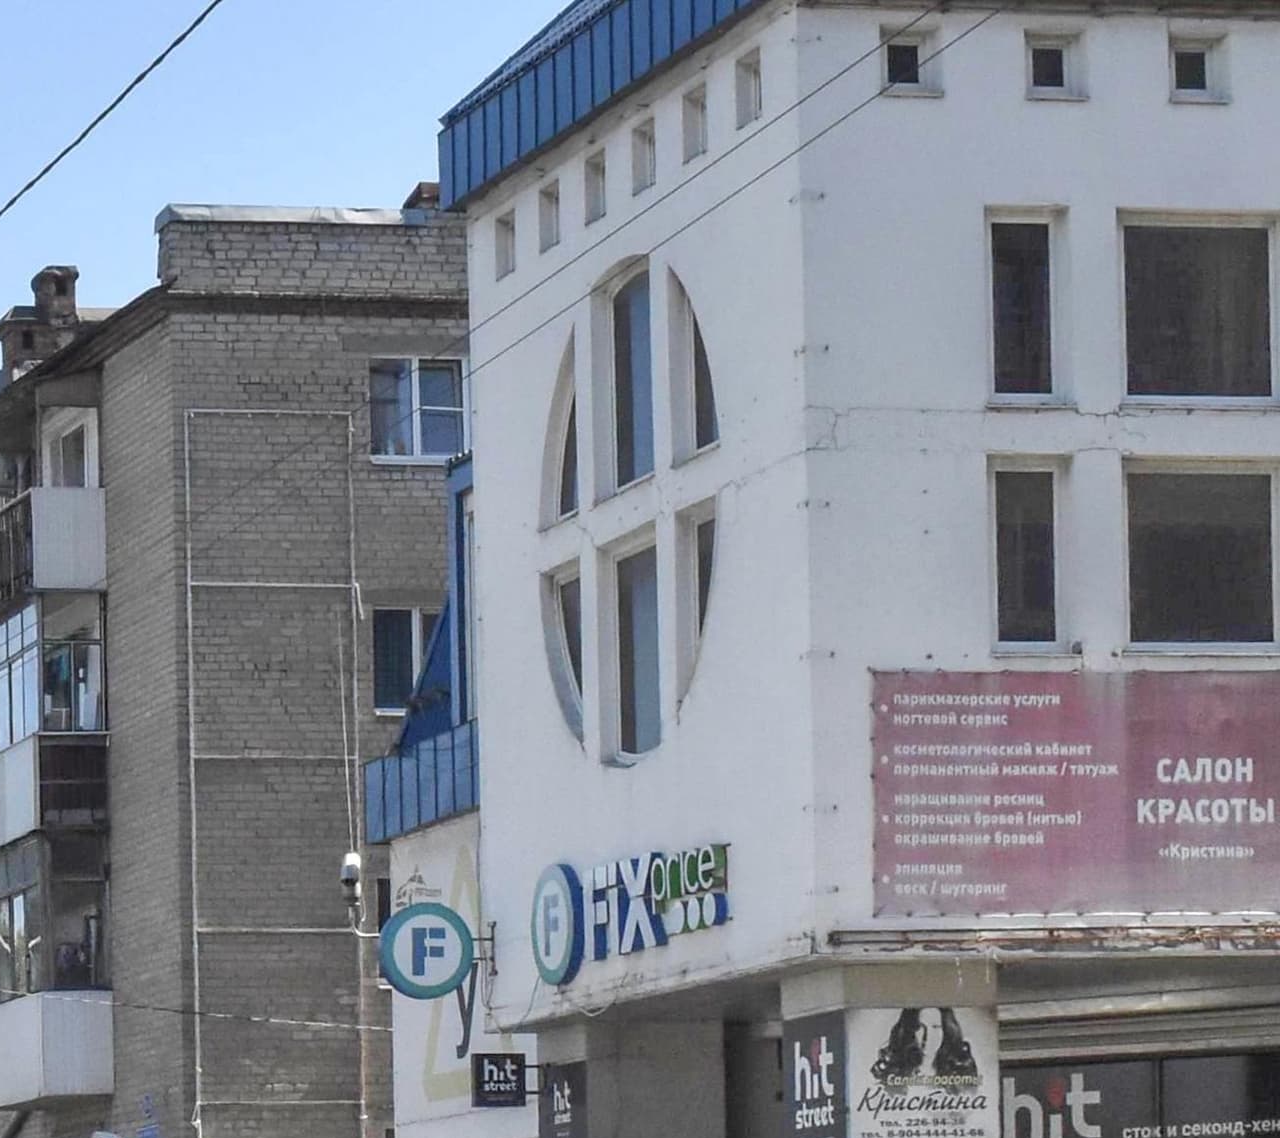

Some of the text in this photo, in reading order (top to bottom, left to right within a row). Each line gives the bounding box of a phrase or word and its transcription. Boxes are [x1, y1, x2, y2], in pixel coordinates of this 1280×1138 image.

[1014, 693, 1060, 707] услуги
[894, 712, 1008, 726] ногтевой сервис
[1036, 742, 1093, 756] кабинет
[1070, 764, 1118, 777] татуаж
[1156, 757, 1254, 783] САЛОН
[894, 810, 1082, 826] коррекция бровей (нитью)
[1136, 797, 1276, 824] КРАСОТЫ
[894, 831, 1045, 846] окрашивание бровей
[894, 863, 963, 876] эпиляция
[940, 882, 1008, 897] шугаринг
[411, 927, 446, 976] F
[483, 1058, 518, 1081] hit
[794, 1036, 834, 1102] hit
[856, 1087, 988, 1120] Кристина
[795, 1098, 835, 1130] street
[1167, 1125, 1178, 1138] и
